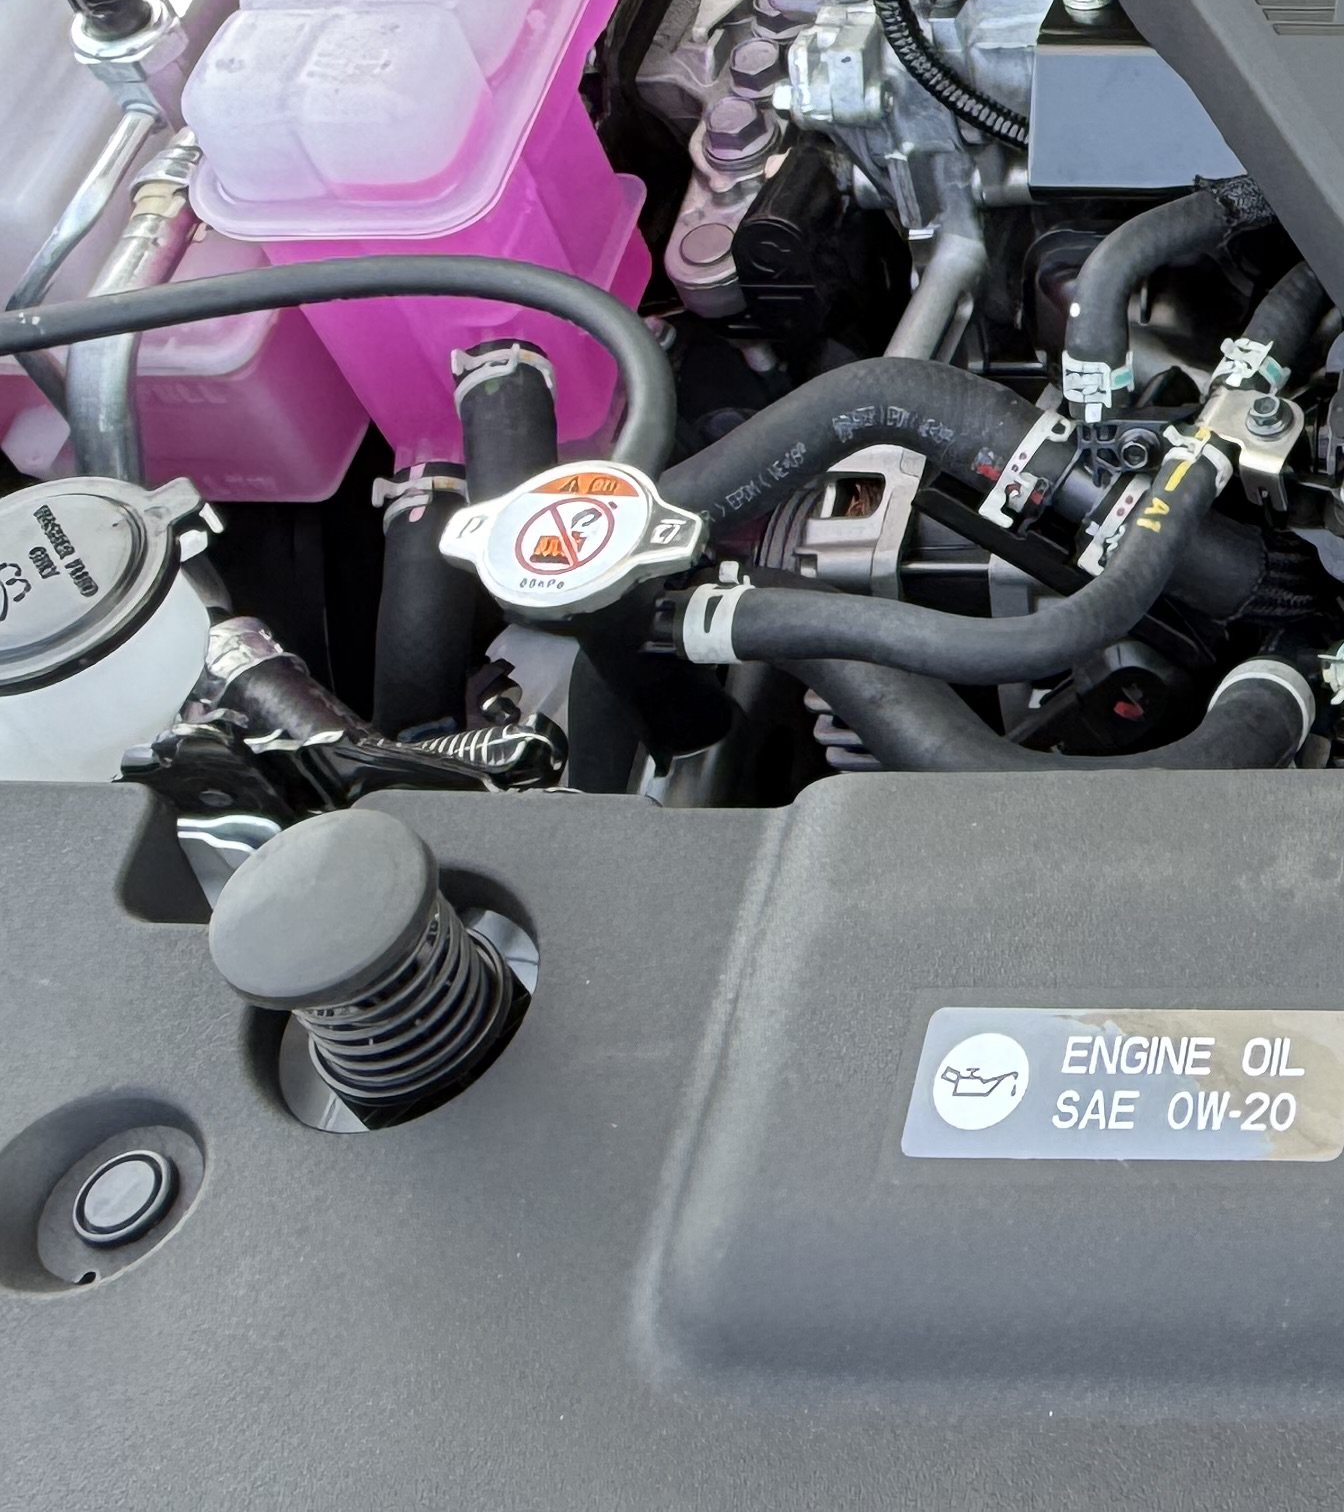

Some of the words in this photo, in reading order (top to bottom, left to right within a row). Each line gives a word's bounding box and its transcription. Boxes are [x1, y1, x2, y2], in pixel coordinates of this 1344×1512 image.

[1060, 1035, 1215, 1076] ENGINE
[1241, 1036, 1305, 1077] OIL
[1051, 1089, 1140, 1130] SAE
[1167, 1091, 1297, 1132] 0W-20
